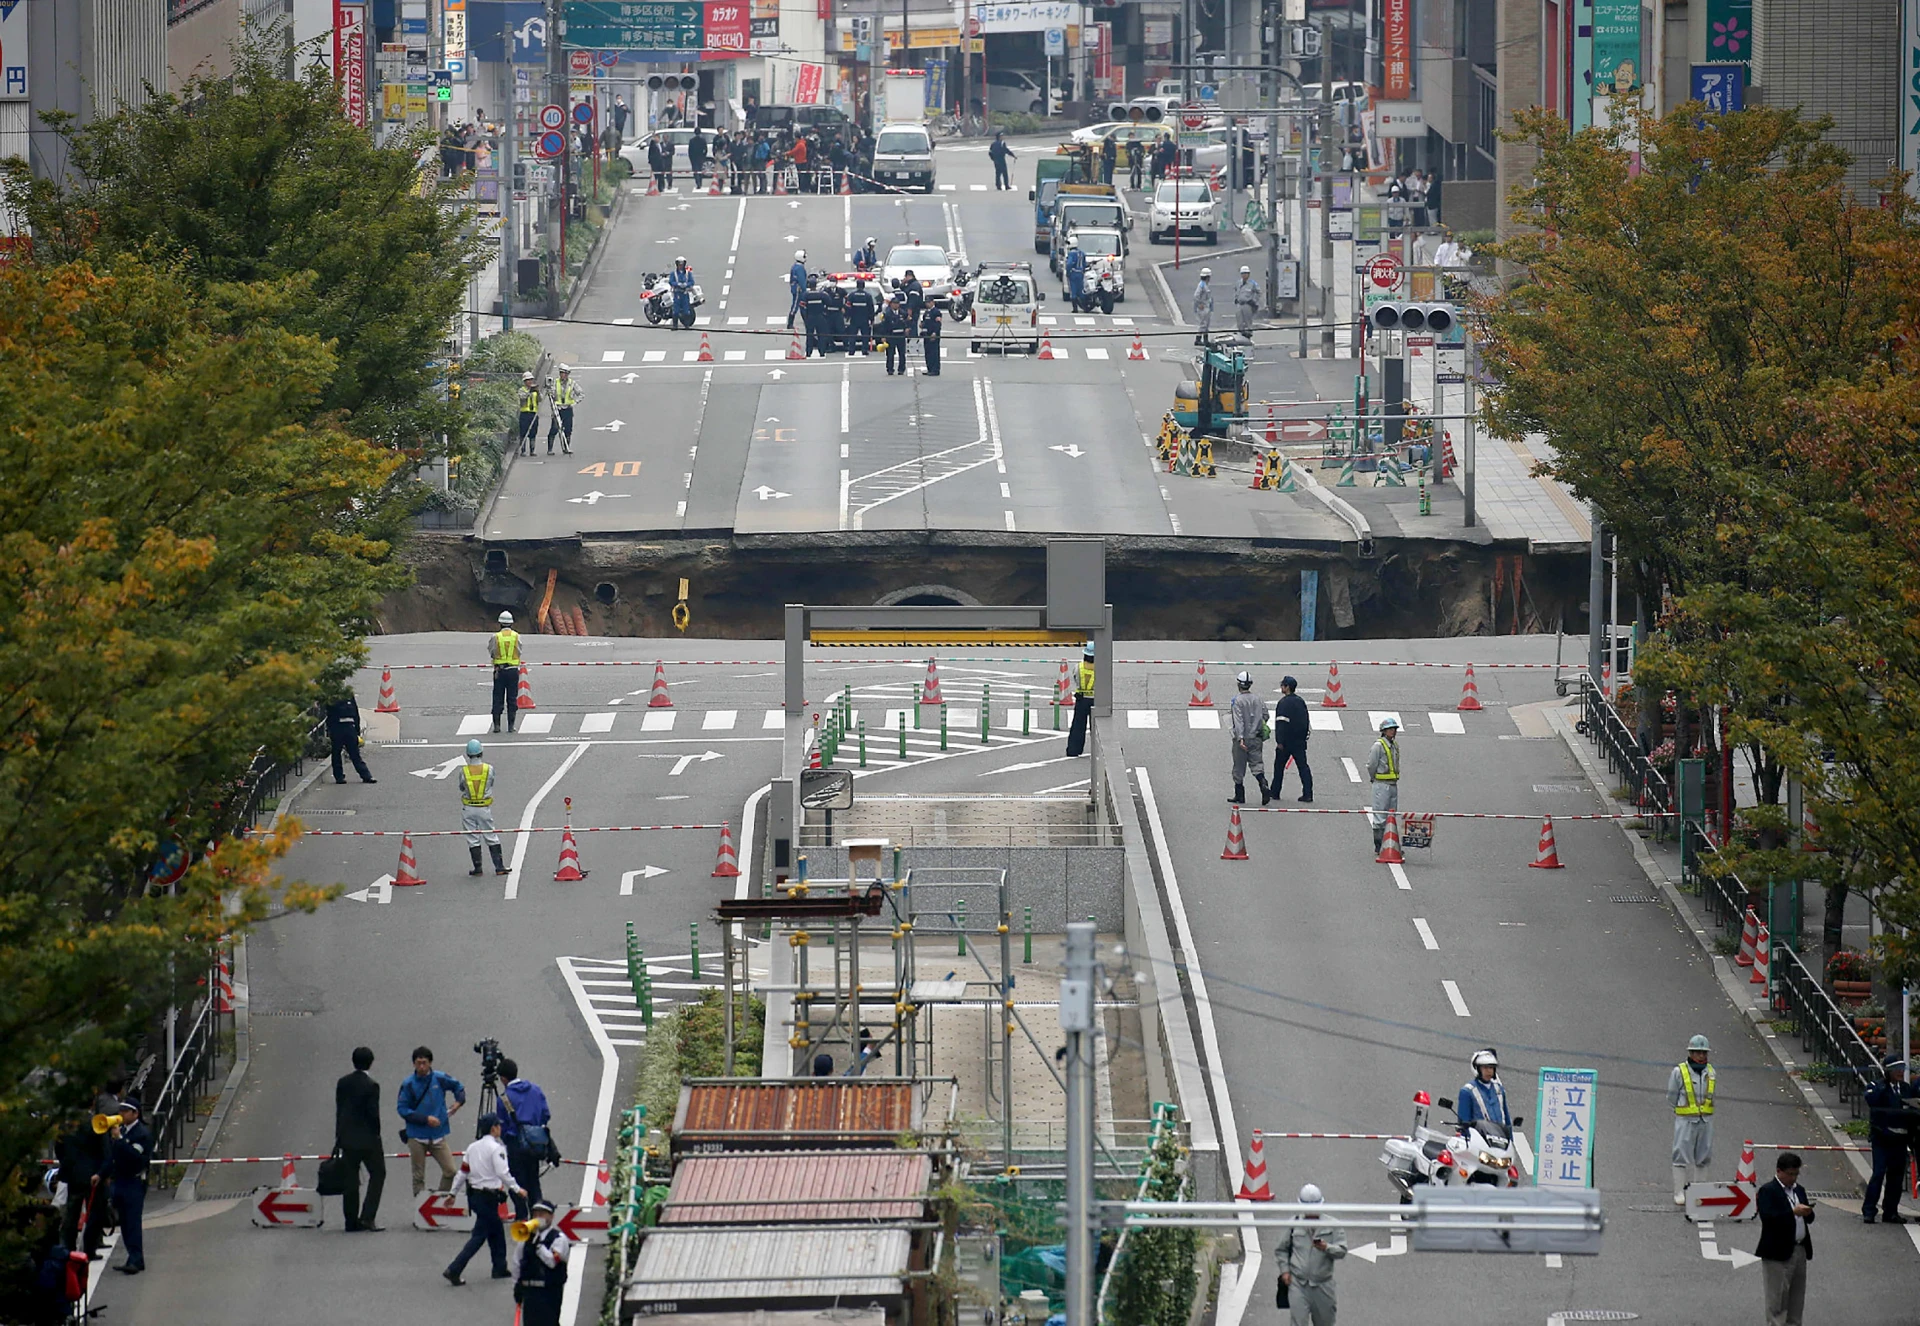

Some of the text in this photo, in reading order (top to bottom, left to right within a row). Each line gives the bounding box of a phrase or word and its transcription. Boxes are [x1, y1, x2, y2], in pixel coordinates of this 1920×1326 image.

[621, 4, 675, 16] 博多区役所
[712, 7, 739, 22] カラオケ
[1595, 5, 1639, 14] エステートプラザ
[722, 32, 744, 49] ECHO
[6, 66, 26, 94] 円
[436, 78, 451, 86] 24h
[545, 112, 560, 124] 40
[1373, 267, 1397, 279] 消火栓
[577, 461, 642, 478] 40
[1544, 1072, 1592, 1082] Do Not Enter
[1559, 1087, 1586, 1180] 立入禁止
